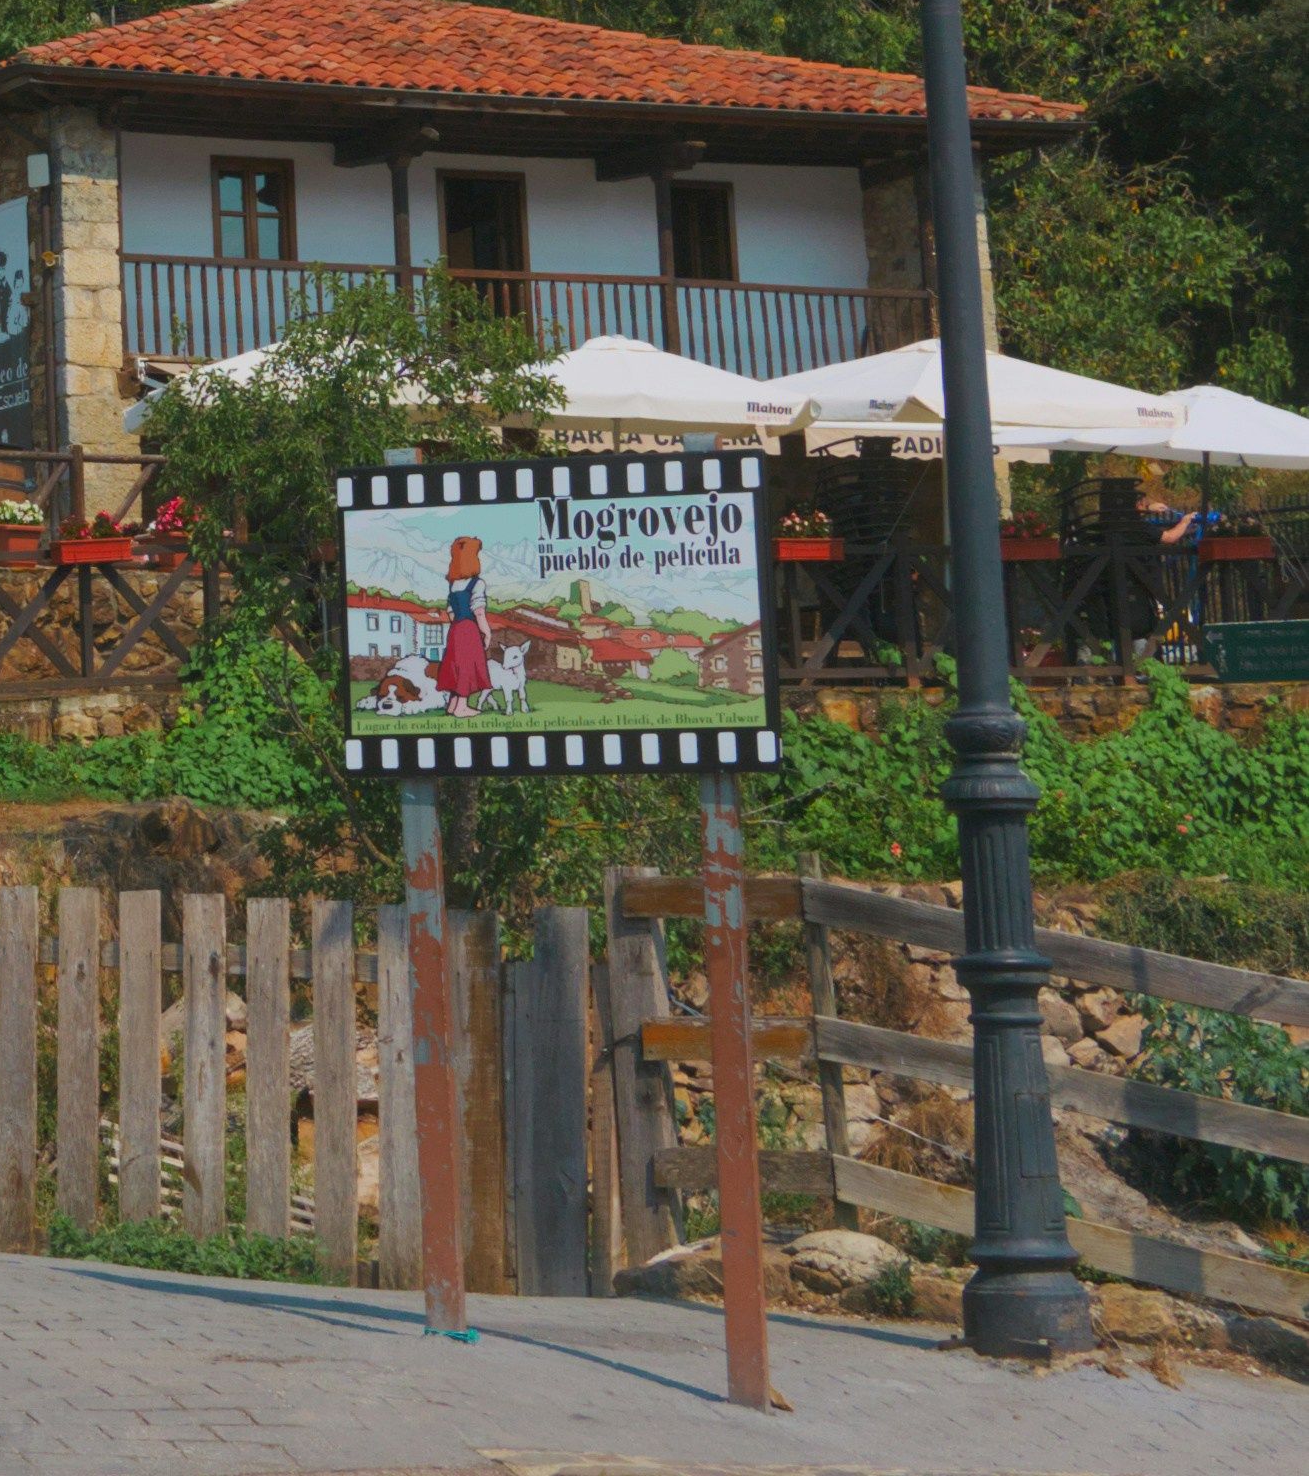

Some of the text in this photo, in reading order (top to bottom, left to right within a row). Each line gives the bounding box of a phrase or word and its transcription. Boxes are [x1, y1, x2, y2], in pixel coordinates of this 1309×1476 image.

[17, 357, 28, 379] de
[747, 401, 792, 414] Mahou
[554, 429, 603, 445] BAR
[536, 492, 743, 550] Mogrovejo
[538, 543, 554, 554] un
[538, 541, 741, 579] pueblo de película
[356, 720, 390, 733] Lugar
[397, 719, 408, 730] de
[411, 719, 446, 734] rodaje
[450, 719, 464, 729] de
[467, 718, 480, 729] la
[482, 717, 523, 731] trilogía
[525, 717, 539, 728] de
[543, 715, 595, 731] películas
[598, 715, 613, 726] de
[657, 713, 672, 725] de
[675, 713, 713, 724] Bhava
[715, 712, 760, 724] Talwar
